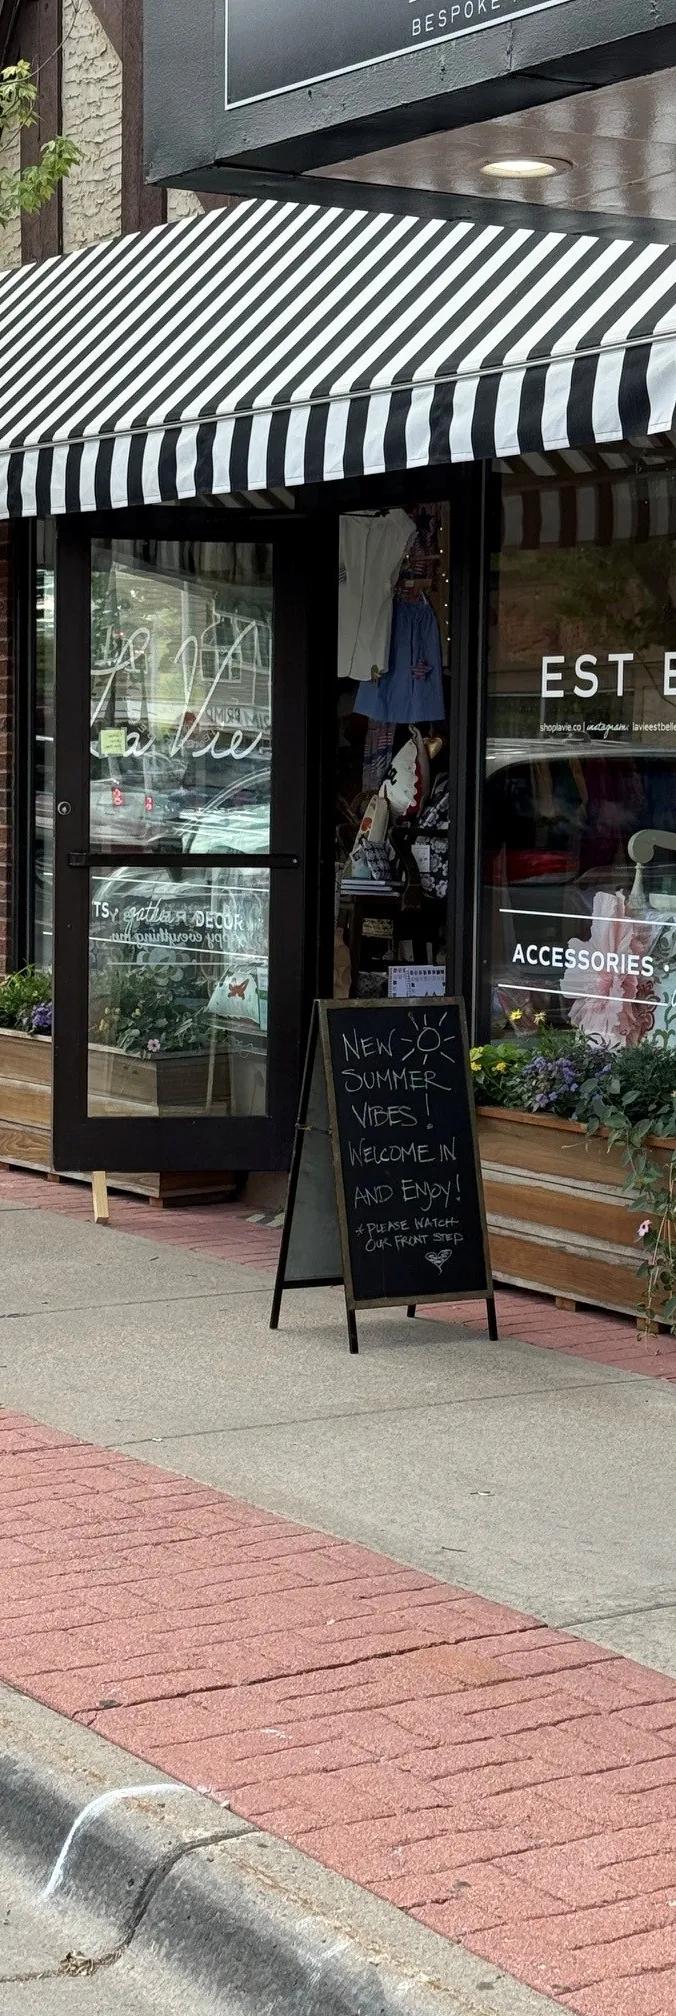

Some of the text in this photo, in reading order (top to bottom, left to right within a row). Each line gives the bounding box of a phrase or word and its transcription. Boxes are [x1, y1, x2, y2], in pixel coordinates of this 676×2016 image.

[412, 0, 501, 36] BESPOKE
[169, 620, 262, 760] Vie
[541, 653, 634, 698] EST
[512, 943, 654, 977] ACCESSORIES
[342, 1028, 396, 1061] NEW
[341, 1067, 451, 1092] SUMMER
[348, 1137, 457, 1166] WELCOME IN
[354, 1185, 394, 1209] AND
[414, 1217, 459, 1230] WATCH
[365, 1232, 464, 1252] OUR FRONT STEP
